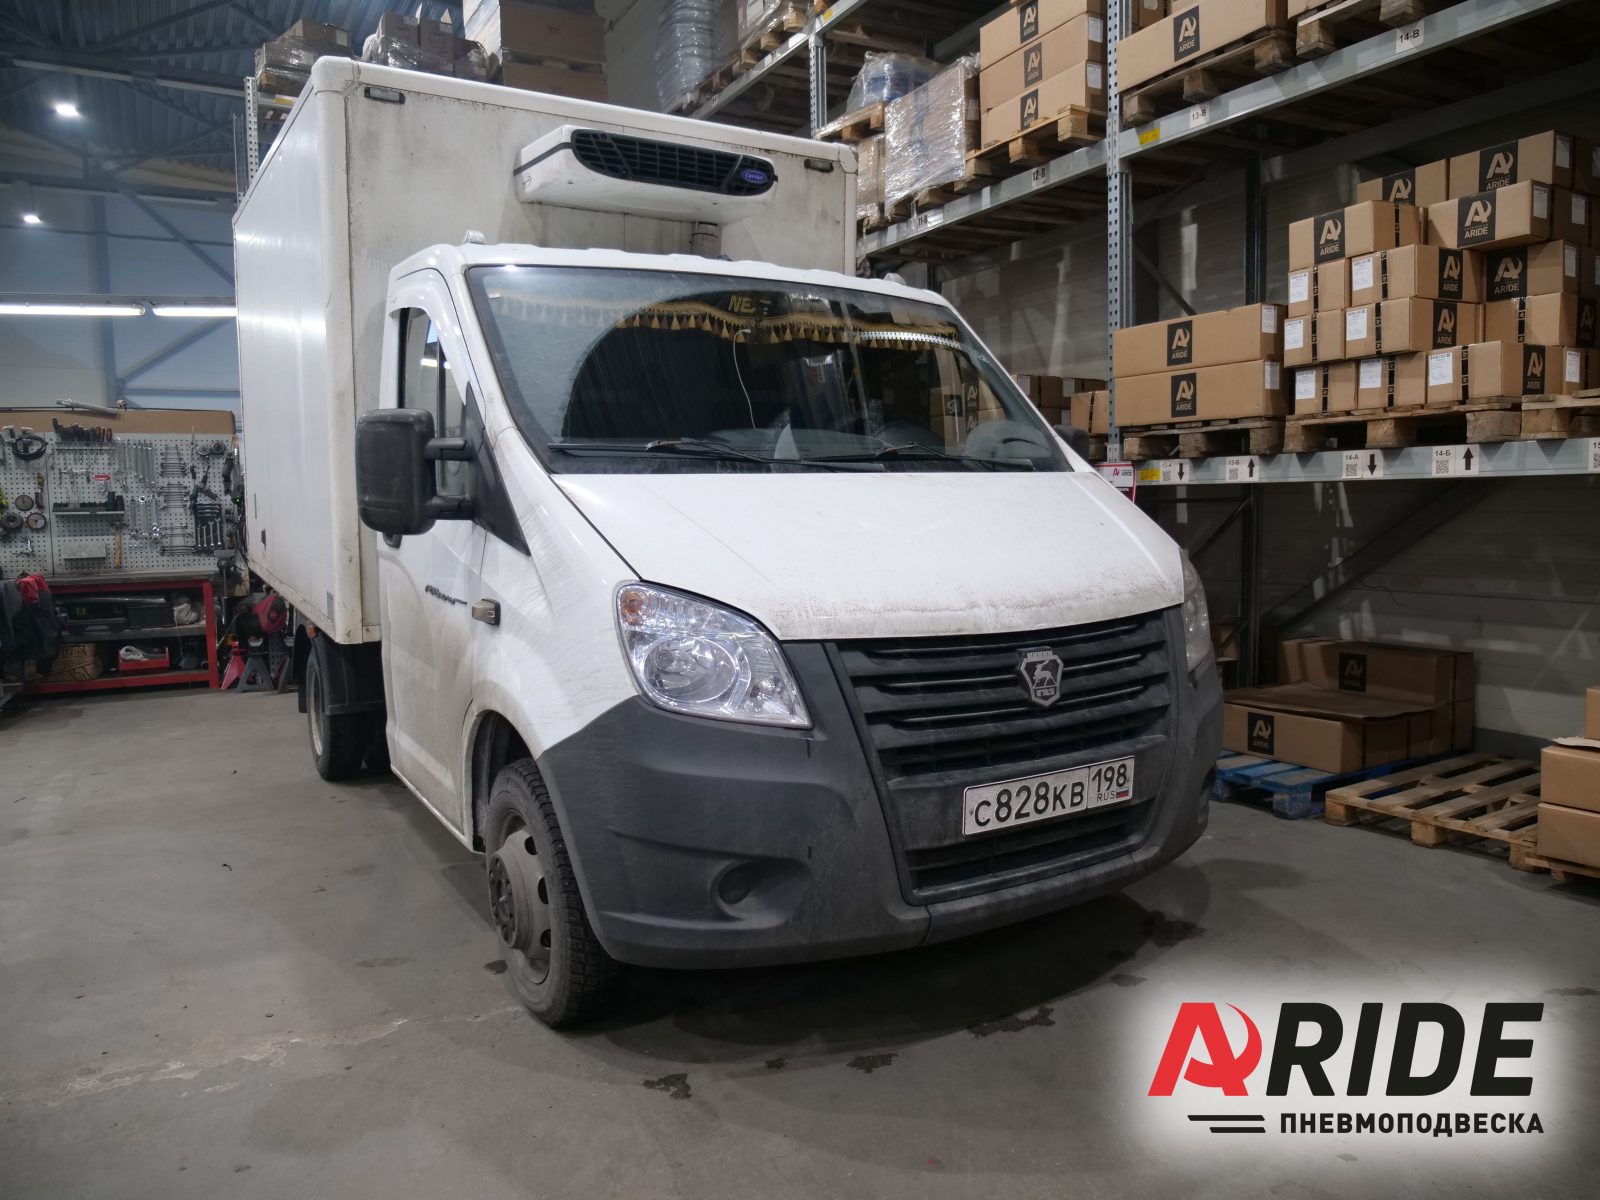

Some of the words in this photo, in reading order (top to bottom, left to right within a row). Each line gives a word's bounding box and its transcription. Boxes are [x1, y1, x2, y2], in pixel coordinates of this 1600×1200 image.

[1179, 39, 1195, 53] ARIDE
[1486, 178, 1510, 190] ARIDE
[1464, 227, 1488, 239] ARIDE
[1320, 244, 1340, 256] ARIDE
[1443, 283, 1459, 292] ARIDE
[1494, 283, 1520, 294] ARIDE
[1171, 351, 1188, 359] ARIDE
[1092, 763, 1128, 793] 198
[1097, 791, 1116, 803] RUS
